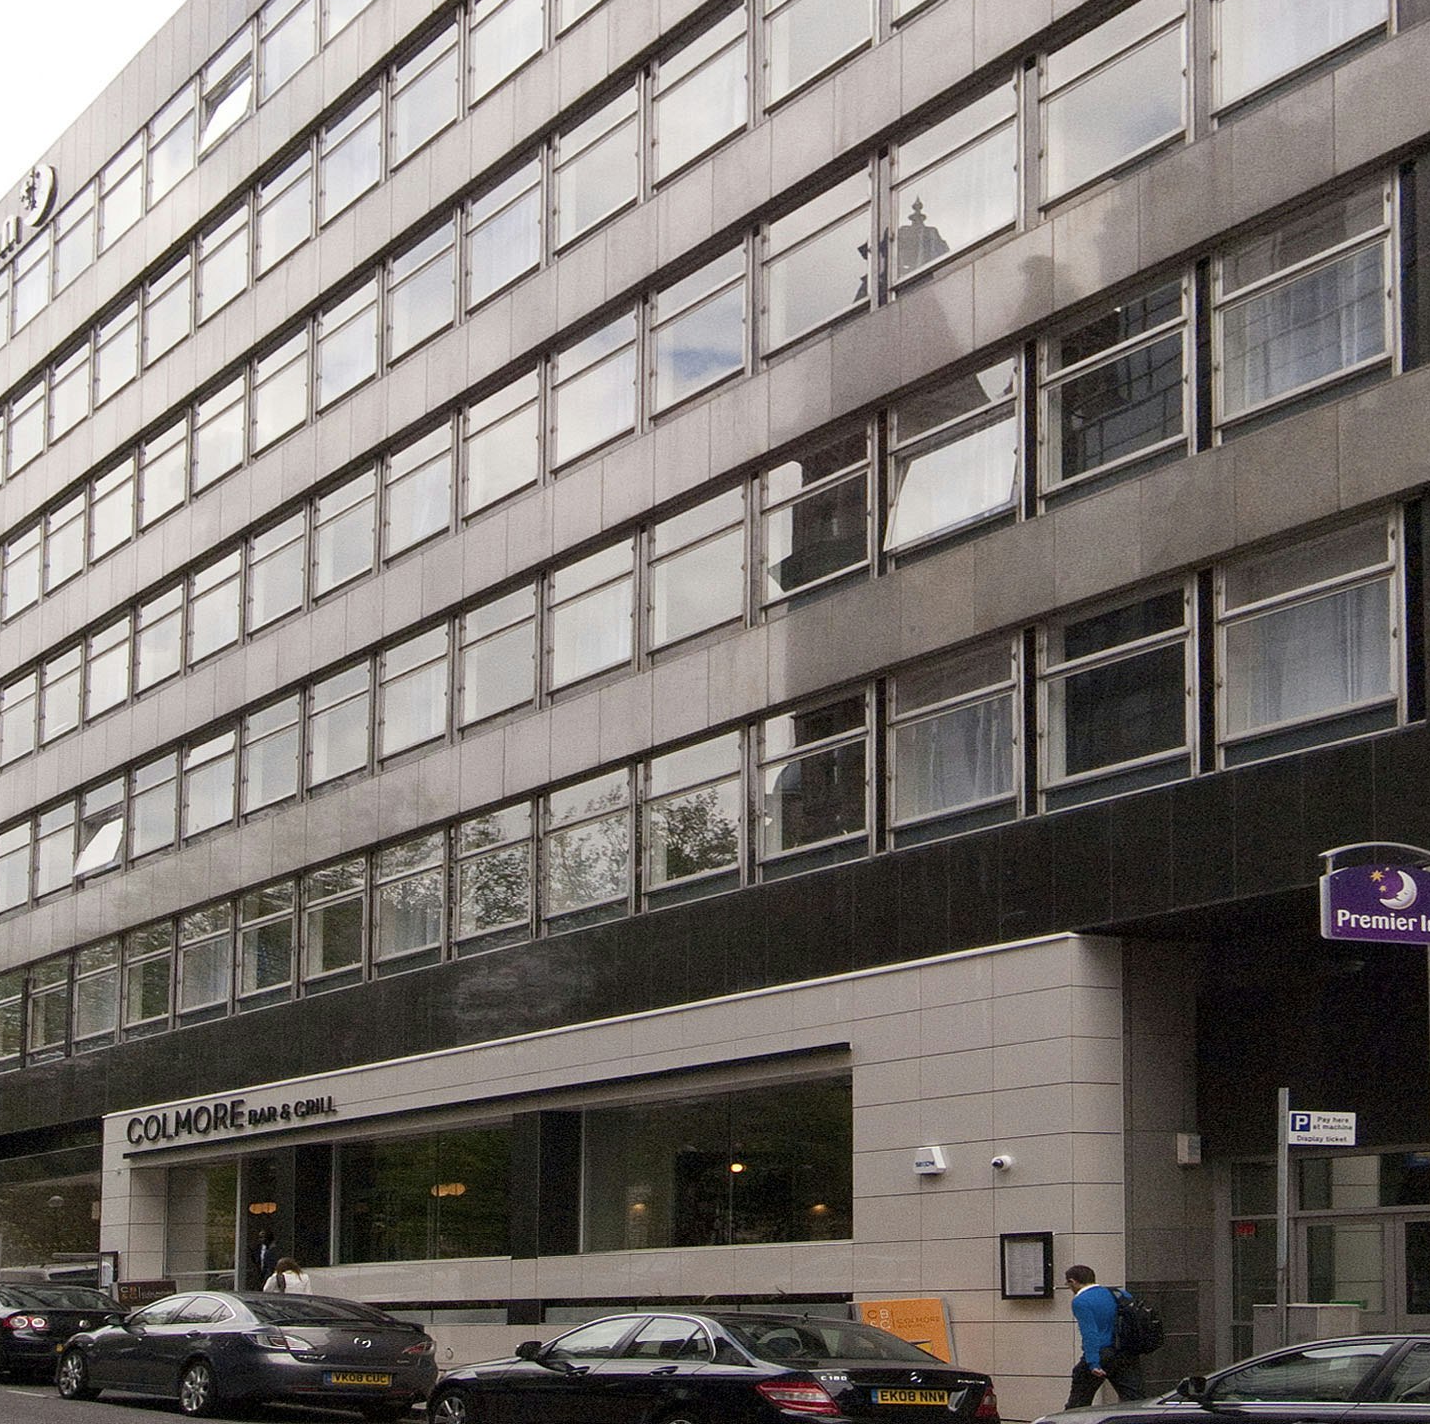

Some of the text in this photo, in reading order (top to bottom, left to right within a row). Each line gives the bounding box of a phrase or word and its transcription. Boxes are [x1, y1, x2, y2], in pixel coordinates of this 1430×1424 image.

[1337, 909, 1417, 932] Premier
[127, 1095, 339, 1145] COLMORE BAR & GRILL
[1295, 1115, 1309, 1131] P
[1317, 1116, 1331, 1124] Pay
[1296, 1135, 1324, 1143] Display
[880, 1390, 946, 1403] EK08 NNW
